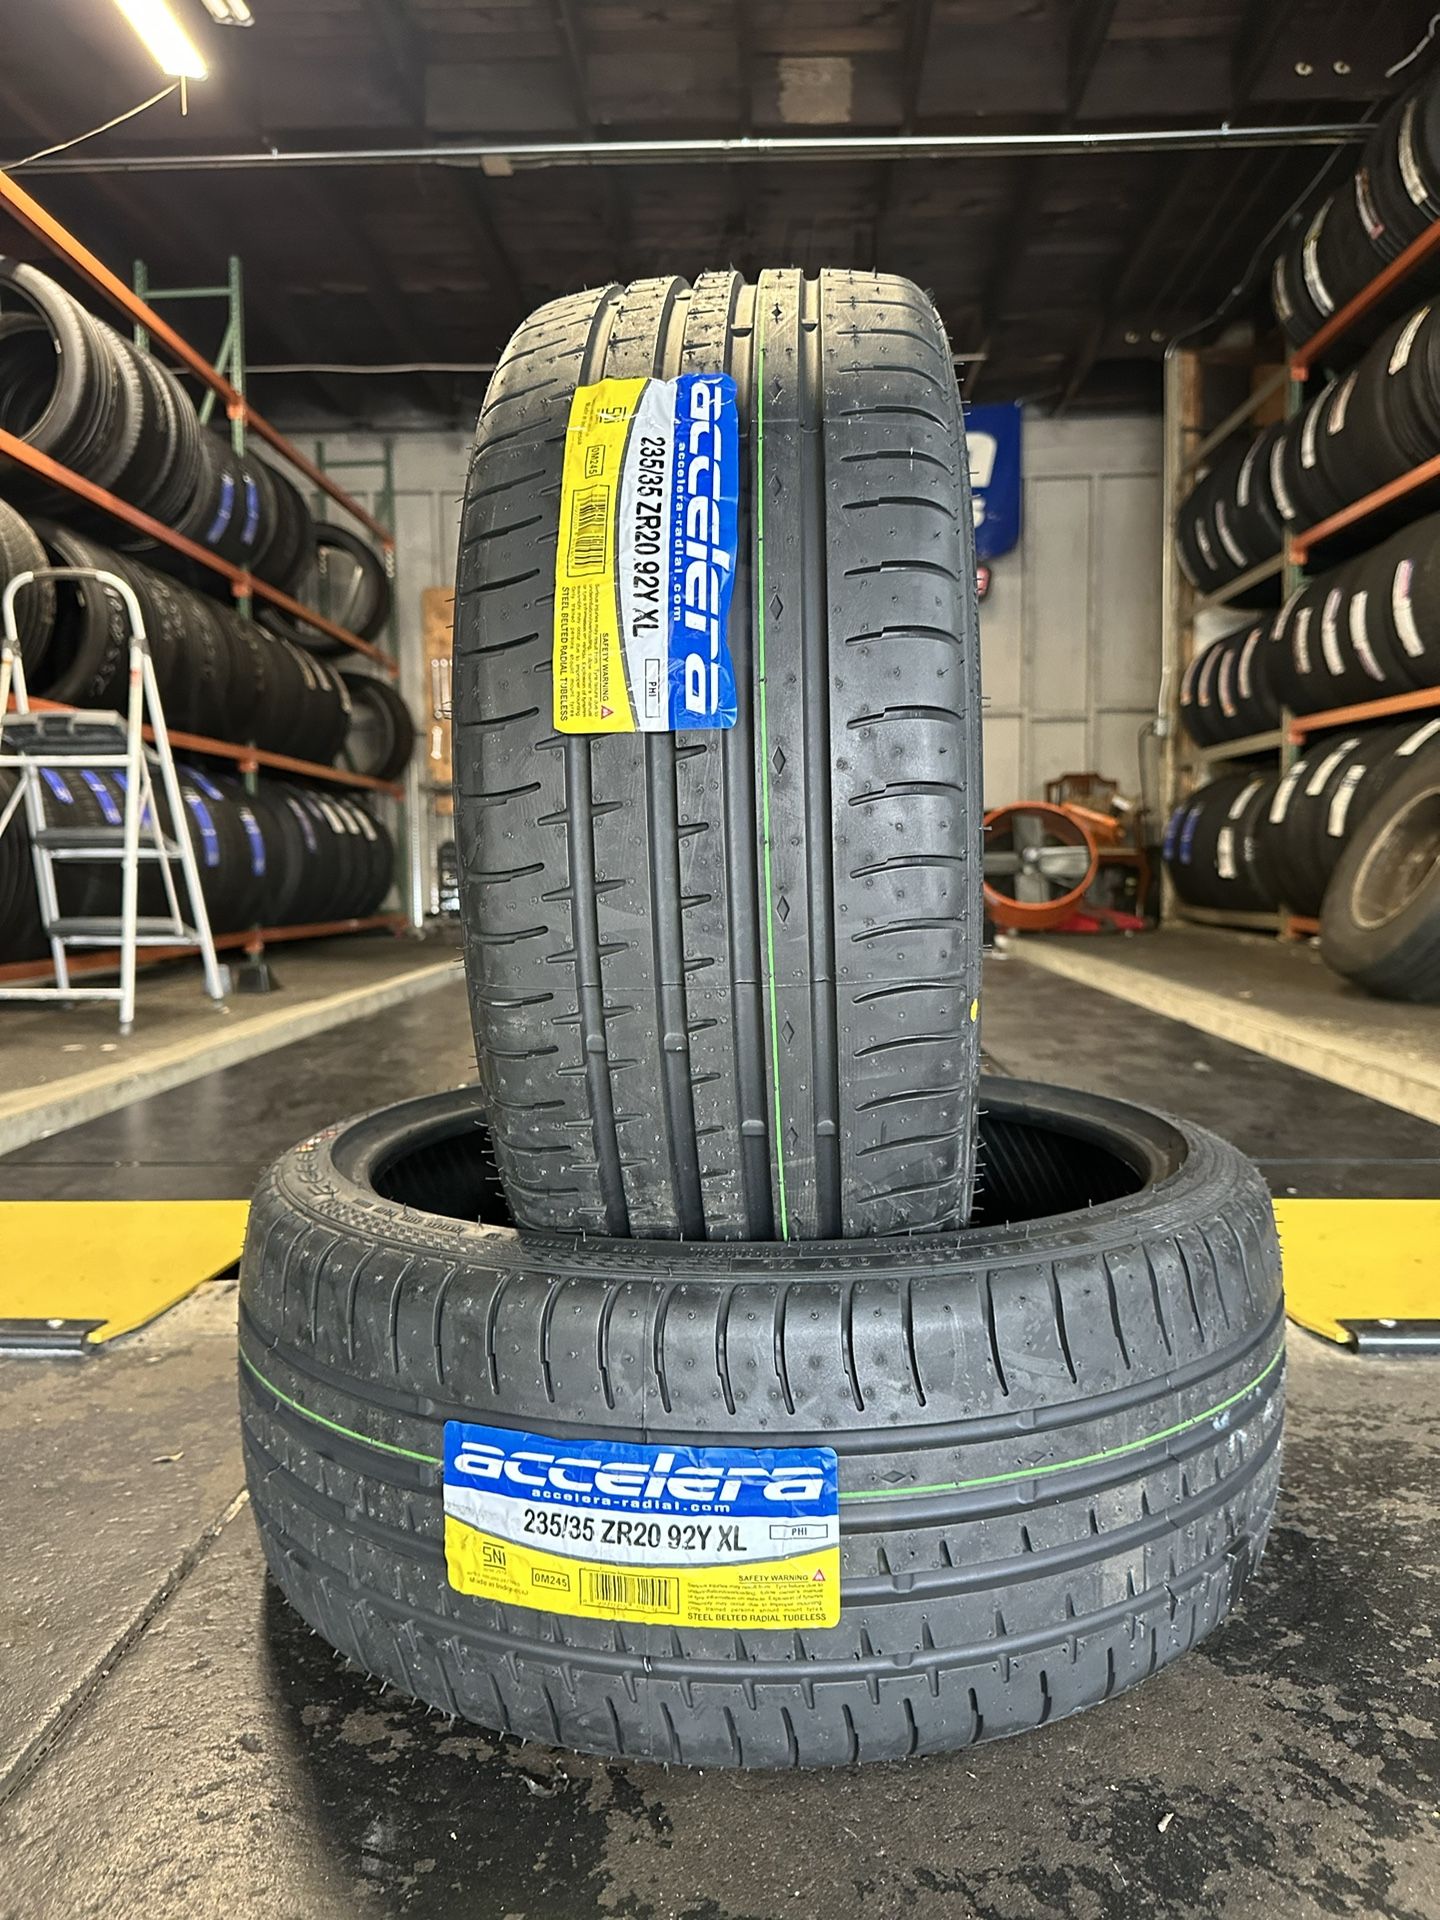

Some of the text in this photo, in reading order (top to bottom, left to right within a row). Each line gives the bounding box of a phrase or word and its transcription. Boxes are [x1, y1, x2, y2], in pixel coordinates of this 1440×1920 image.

[632, 437, 666, 638] 235/35 ZR20 92Y XL
[673, 442, 686, 622] accelera-radial.com
[685, 382, 730, 715] accelera
[561, 587, 569, 610] STEEL
[560, 678, 568, 721] TUBELESS
[648, 681, 656, 698] PHI
[454, 1441, 824, 1501] accelera
[531, 1488, 730, 1513] accelera-radial.com
[523, 1509, 747, 1551] 235/35 ZR20 92Y XL
[791, 1528, 808, 1536] PHI
[483, 1546, 506, 1566] SNI
[688, 1613, 713, 1621] STEEL
[750, 1613, 780, 1622] RADIAL
[783, 1613, 826, 1621] TUBELESS
